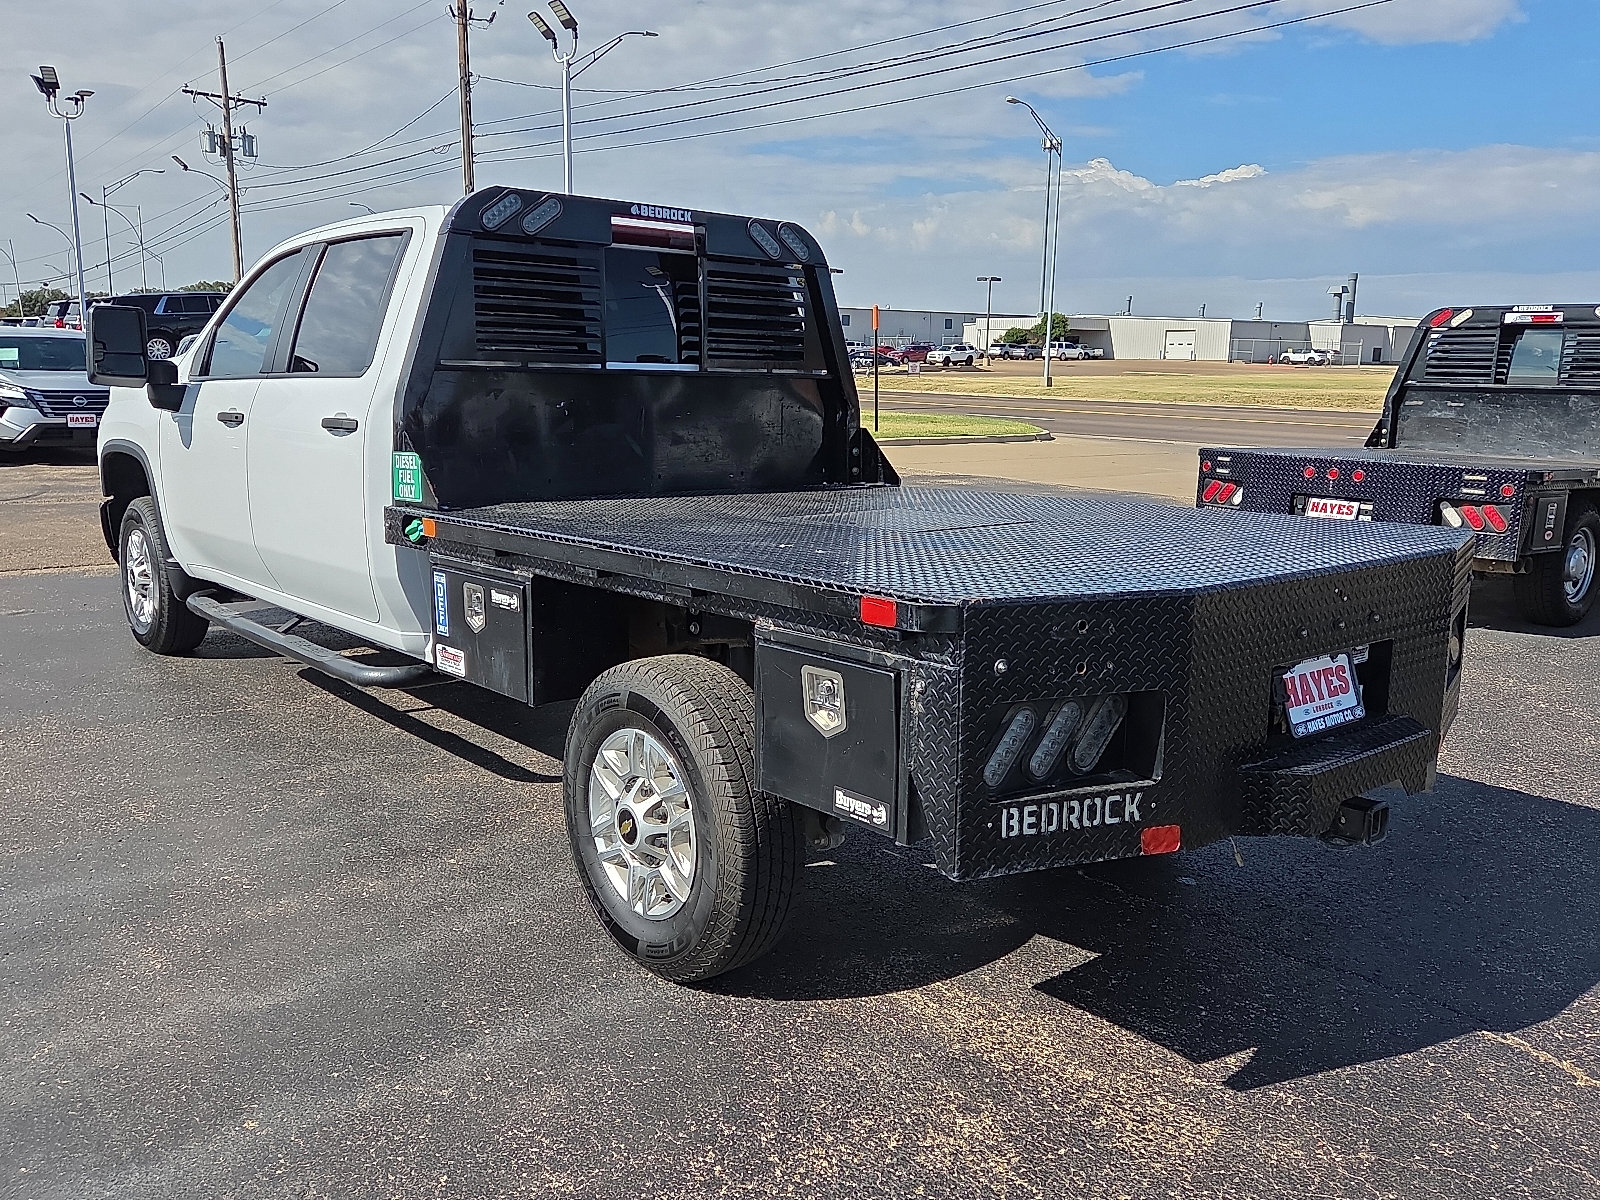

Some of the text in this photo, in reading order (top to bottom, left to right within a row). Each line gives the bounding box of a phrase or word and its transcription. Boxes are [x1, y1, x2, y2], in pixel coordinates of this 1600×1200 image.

[640, 204, 692, 222] BEDROCK
[395, 454, 417, 469] DIESEL
[398, 469, 415, 484] FUEL
[398, 484, 416, 498] ONLY
[1310, 501, 1354, 516] HAYES
[437, 583, 446, 625] DEF
[1284, 664, 1350, 709] HAYES
[1307, 718, 1326, 733] HAYES
[1325, 712, 1345, 728] MOTOR
[835, 789, 872, 815] Buyers
[1001, 792, 1143, 839] BEDROCK
